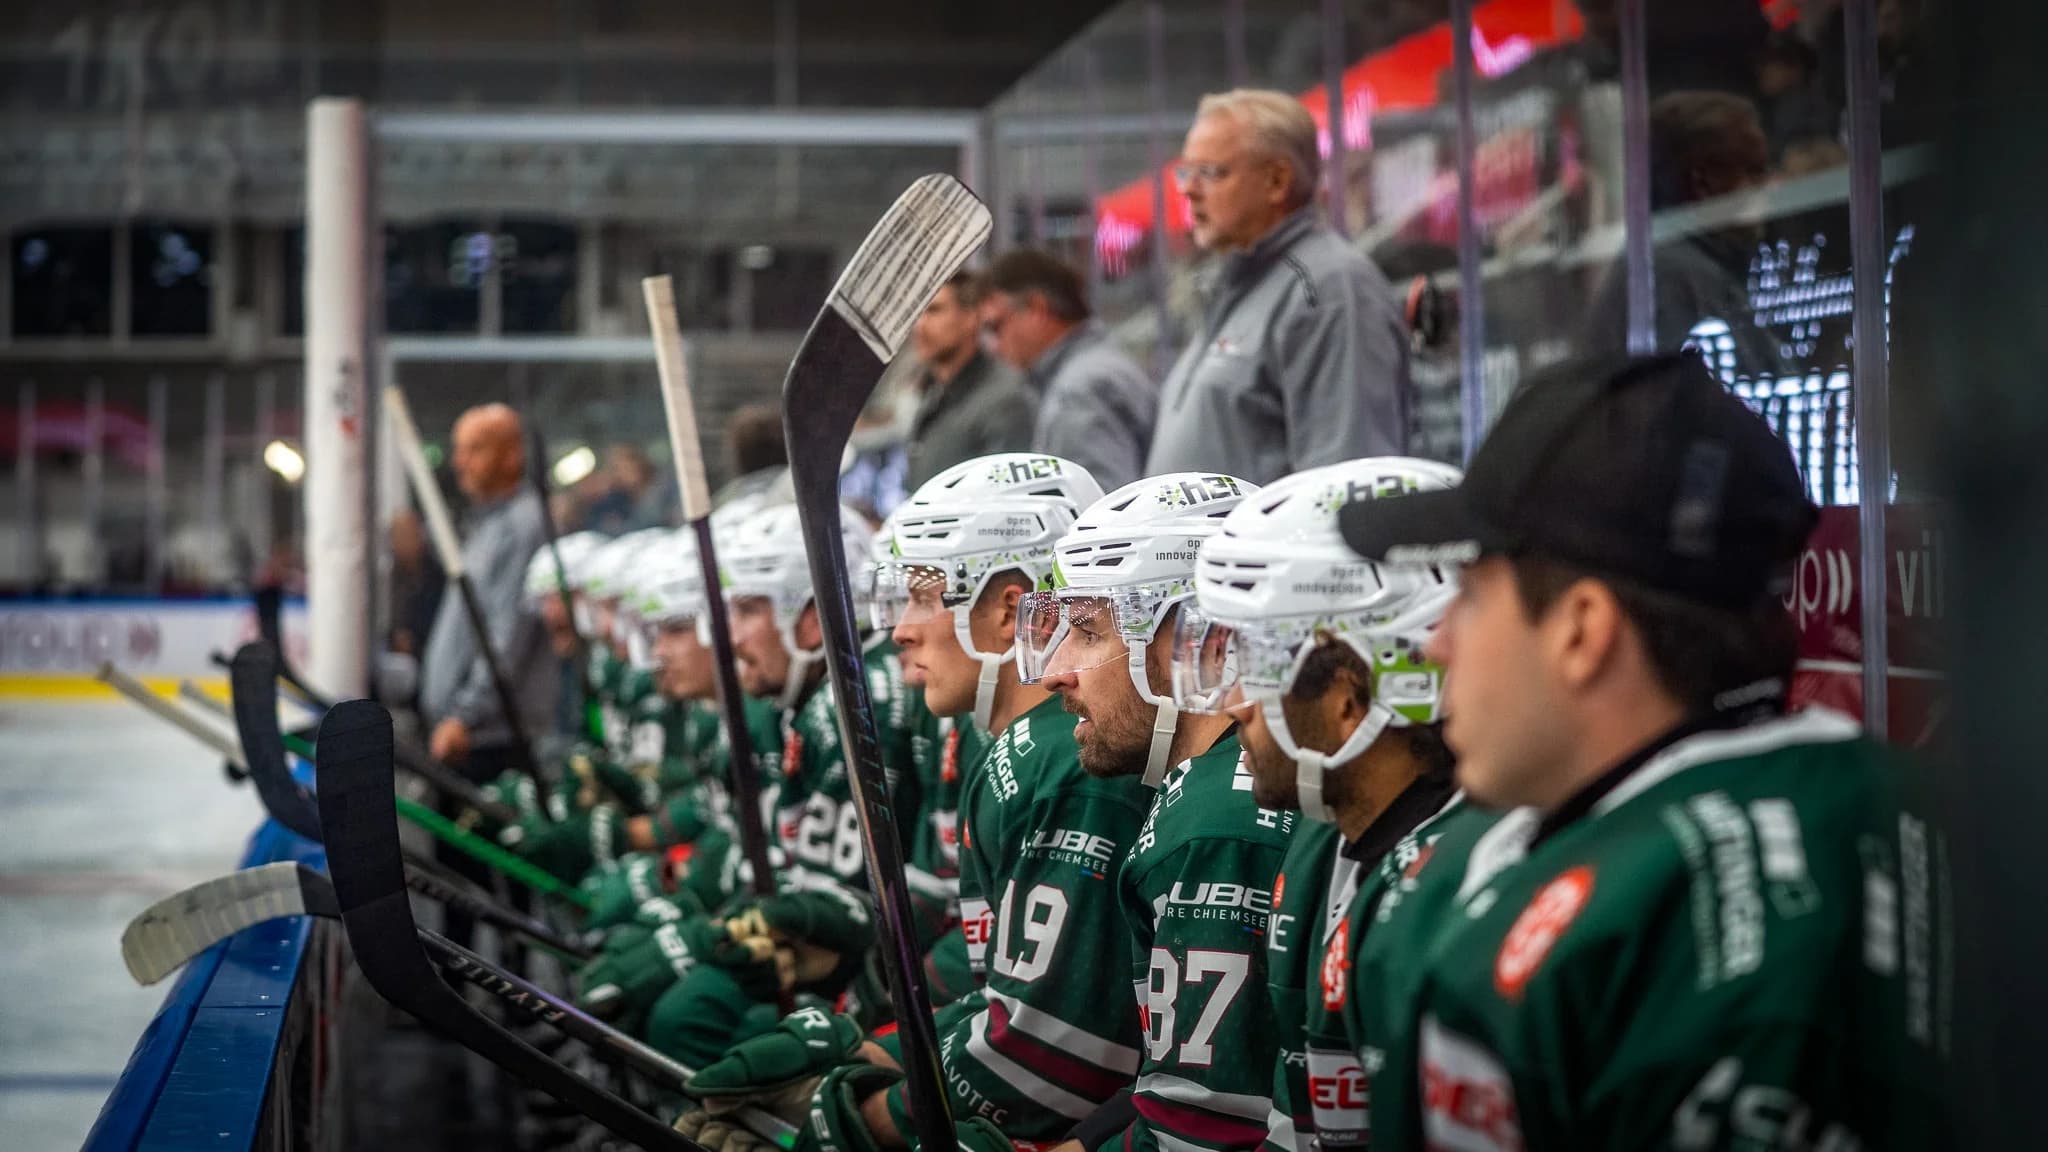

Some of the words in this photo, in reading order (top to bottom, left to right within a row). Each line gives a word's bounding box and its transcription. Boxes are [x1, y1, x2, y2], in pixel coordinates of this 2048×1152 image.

[977, 527, 1031, 537] innovation
[1007, 517, 1031, 527] open
[1187, 539, 1201, 549] op
[1156, 550, 1198, 561] innovat
[1282, 809, 1294, 834] UNT
[1024, 829, 1117, 862] UBE
[1048, 852, 1108, 874] CHIEMSEE
[1193, 908, 1266, 928] CHIEMSEE
[993, 879, 1069, 983] 19
[1150, 948, 1250, 1067] 87
